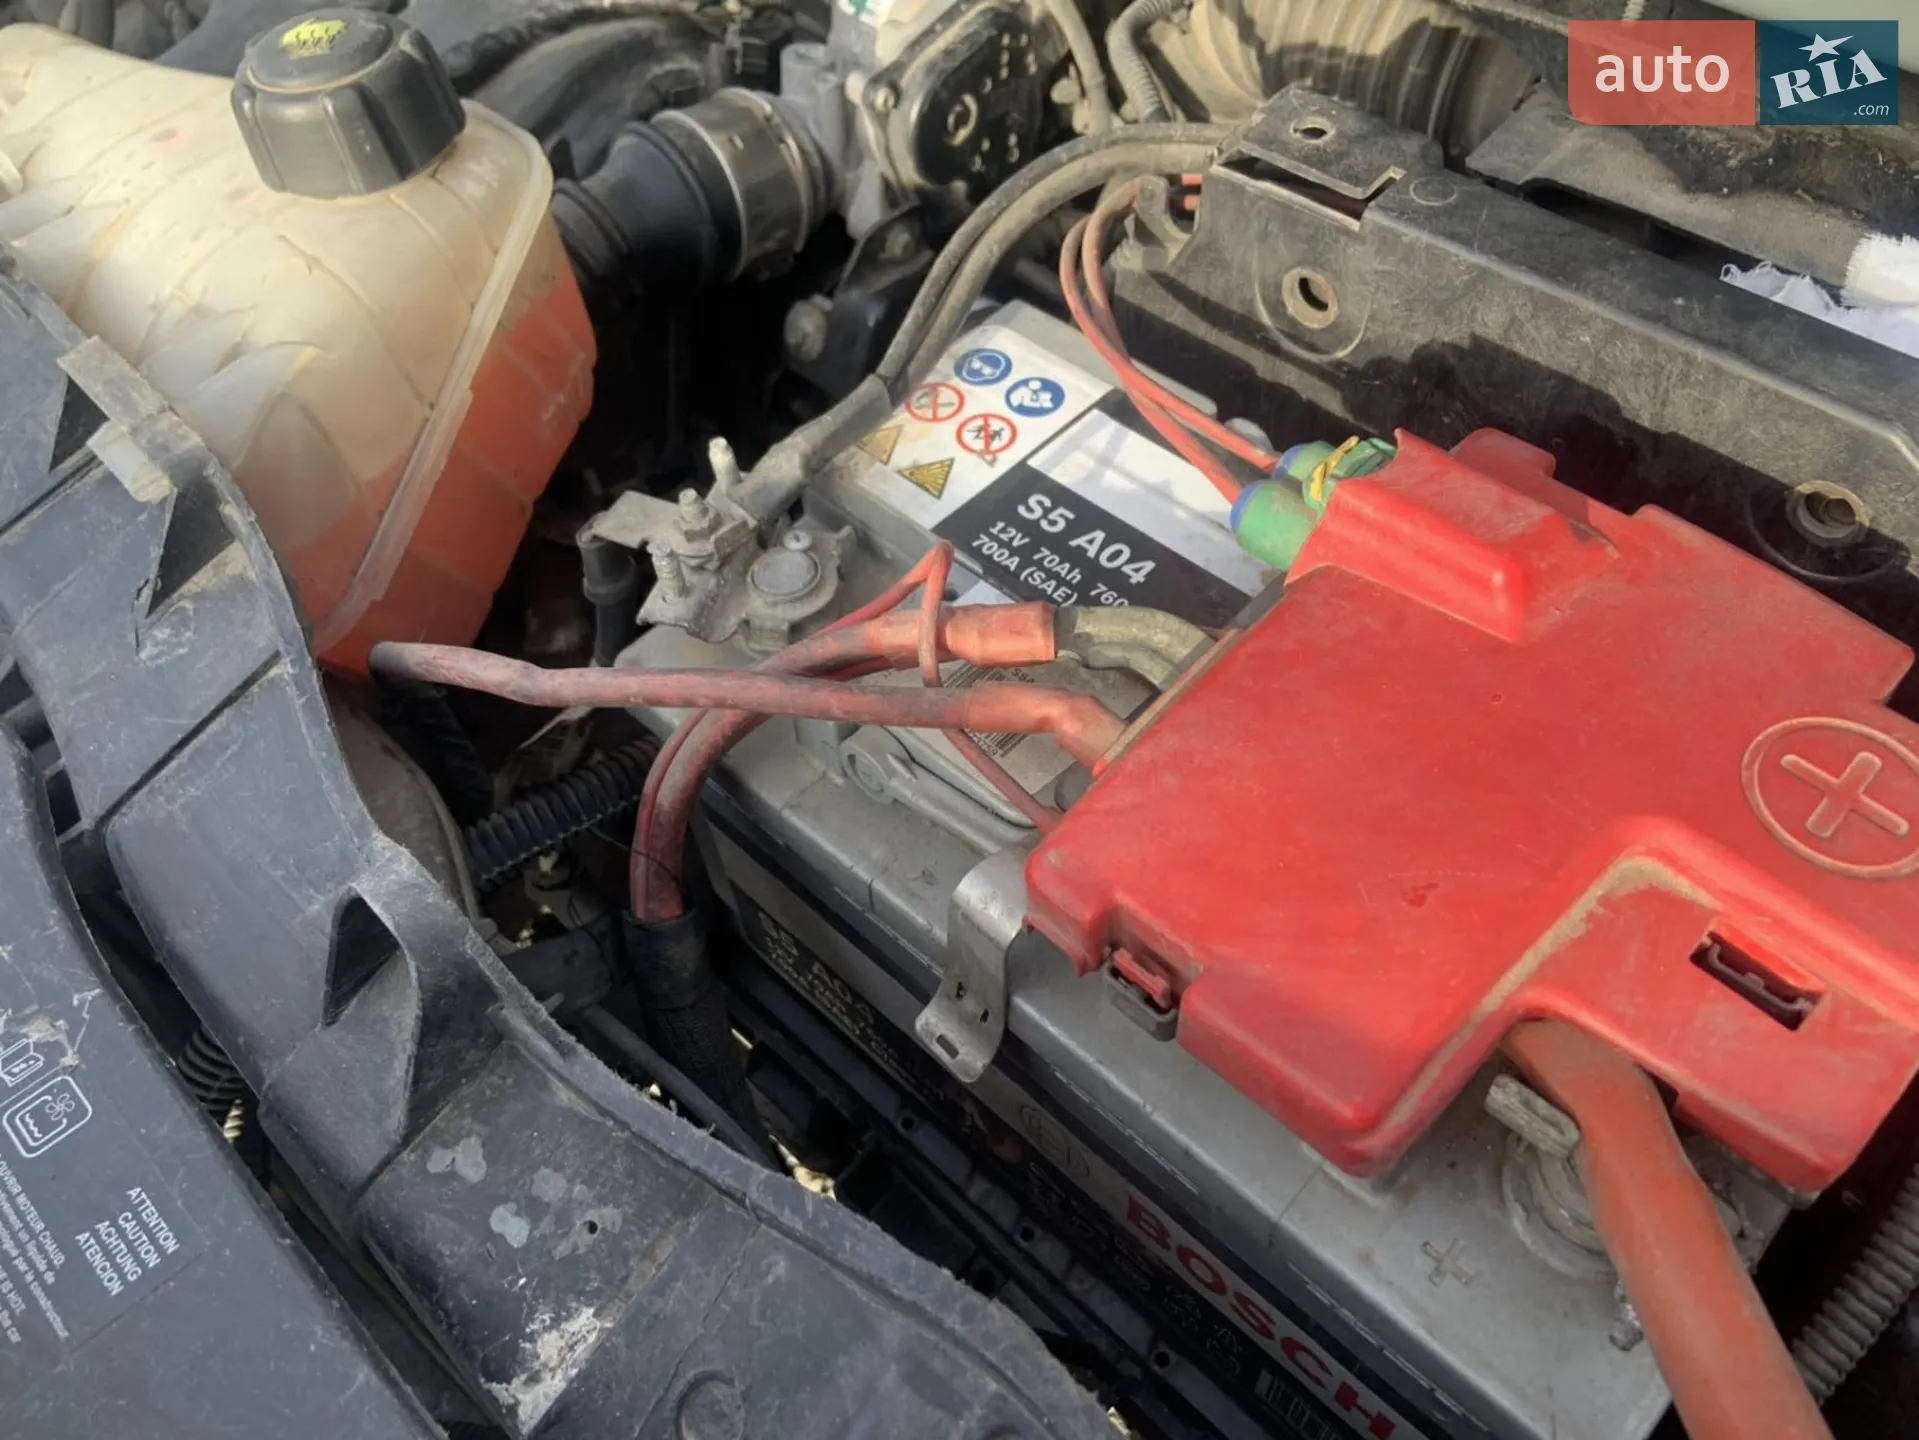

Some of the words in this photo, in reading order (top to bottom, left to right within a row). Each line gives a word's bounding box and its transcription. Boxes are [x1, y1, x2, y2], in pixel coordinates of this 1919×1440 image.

[972, 534, 1020, 572] 700A
[1020, 566, 1079, 608] (SAE)
[989, 521, 1031, 548] 12V
[1032, 546, 1083, 585] 70Ah
[1017, 493, 1076, 534] S5
[1068, 529, 1157, 586] A04
[15, 1192, 45, 1235] MOTEUR
[118, 1211, 161, 1269] CAUTION
[126, 1186, 180, 1255] ATTENTION
[75, 1231, 124, 1297] ATENCION
[94, 1220, 142, 1281] ACHTUNG
[1125, 1195, 1398, 1440] BOSCH
